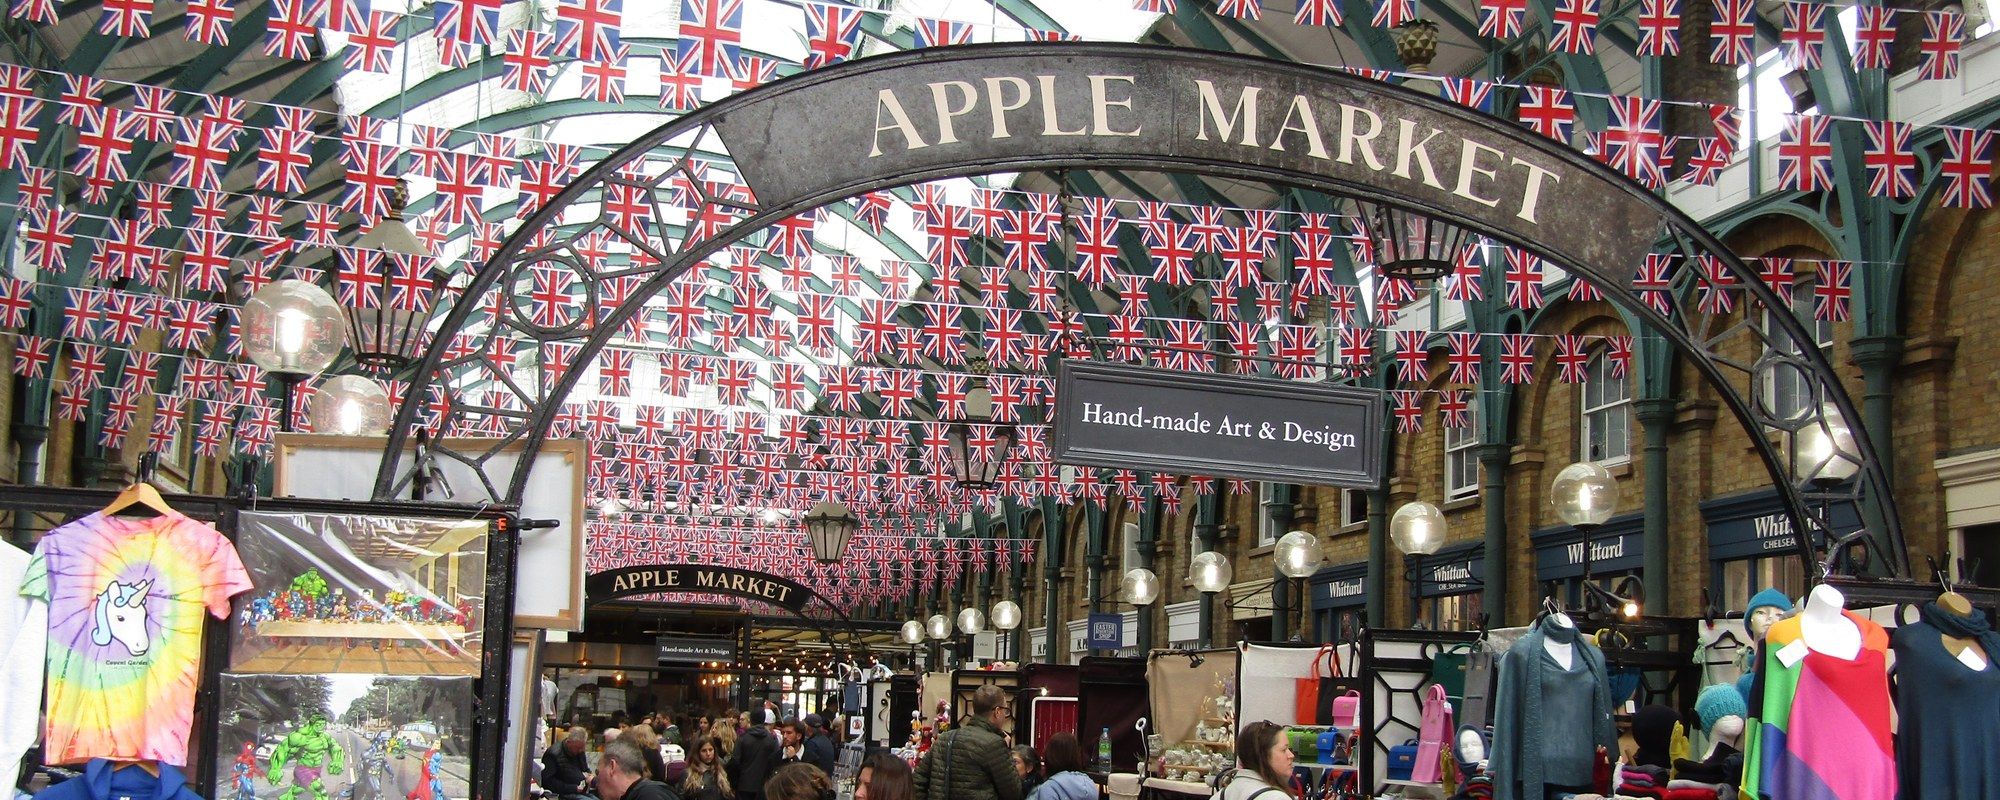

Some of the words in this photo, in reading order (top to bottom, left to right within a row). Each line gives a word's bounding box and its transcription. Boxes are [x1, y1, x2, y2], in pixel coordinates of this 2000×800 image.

[868, 75, 1143, 158] APPLE
[1194, 79, 1561, 225] MARKET
[1081, 402, 1211, 434] Hand-made
[1216, 414, 1252, 438] Art
[1258, 421, 1276, 441] &
[1283, 421, 1356, 451] Design
[1763, 538, 1797, 550] CHELSEA
[613, 569, 680, 592] APPLE
[696, 571, 792, 602] MARKET
[1328, 578, 1363, 598] Whittard
